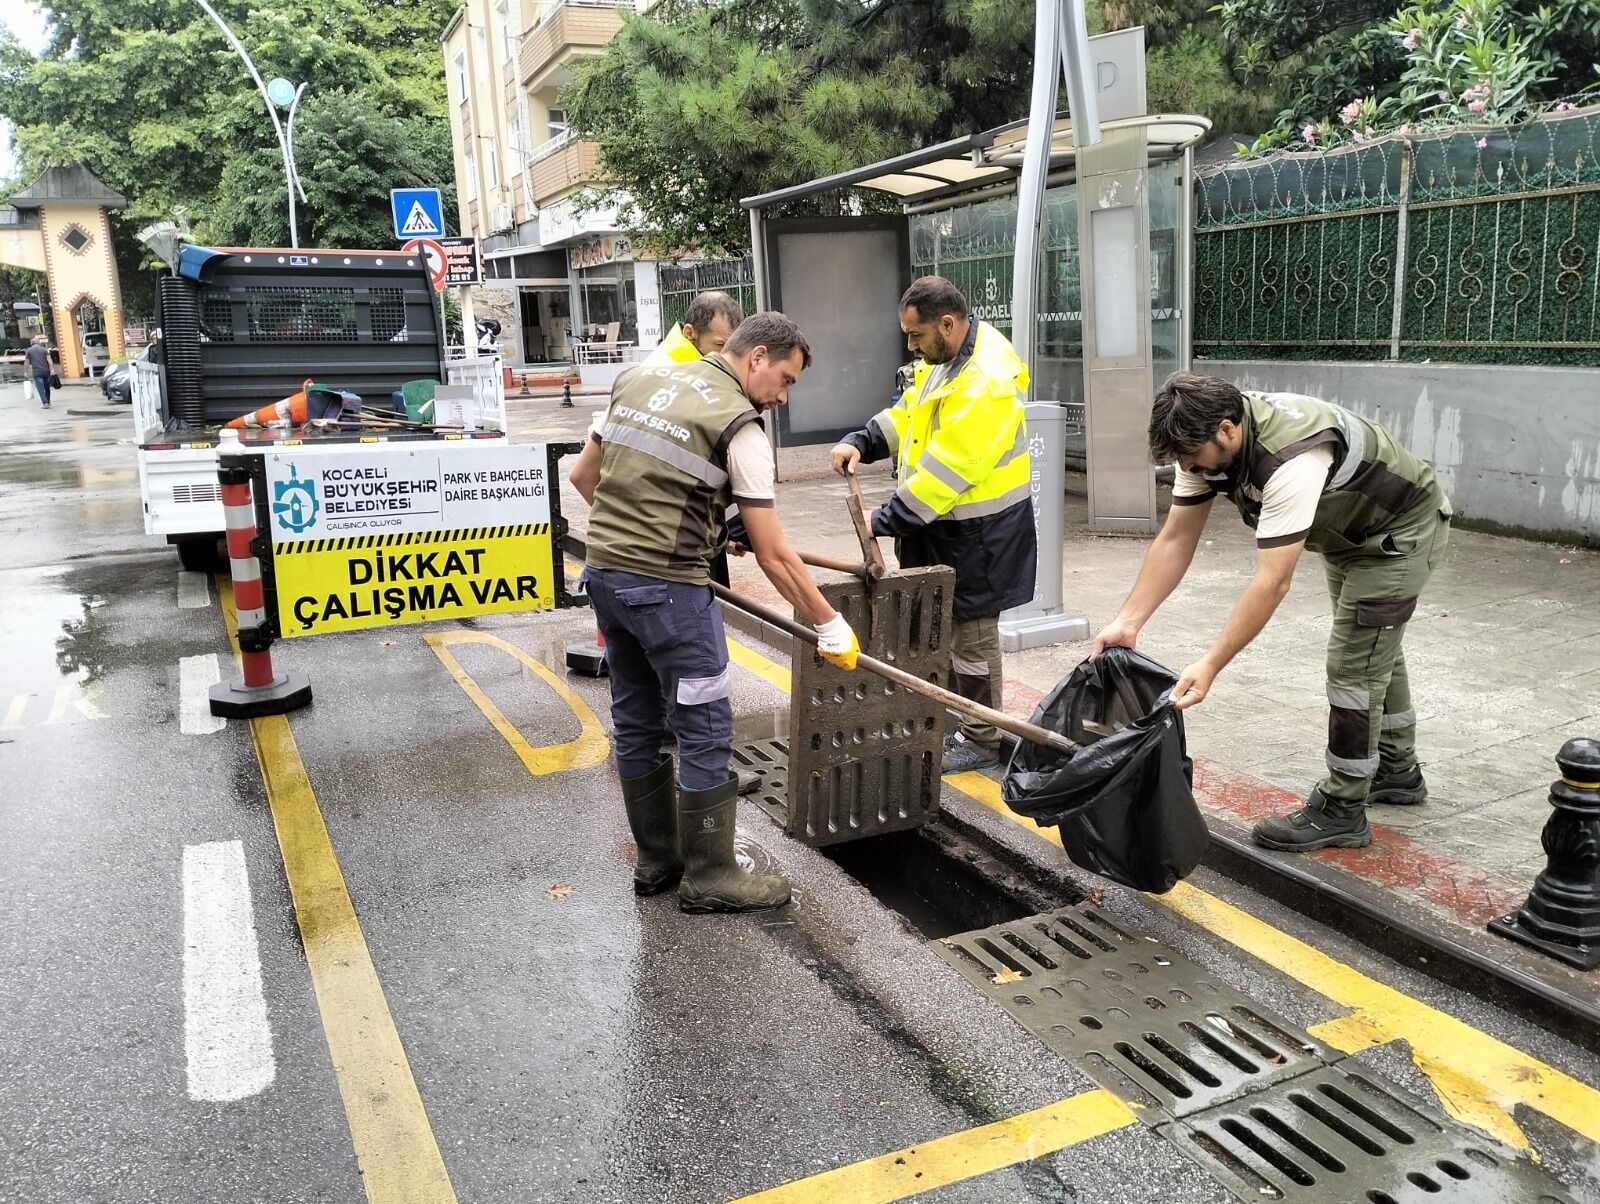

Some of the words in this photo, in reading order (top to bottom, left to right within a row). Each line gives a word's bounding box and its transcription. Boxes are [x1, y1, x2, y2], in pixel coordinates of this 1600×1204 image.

[444, 472, 472, 484] PARK
[474, 471, 487, 483] VE
[490, 469, 543, 484] BAHÇELER
[445, 487, 478, 502] DAİRE
[481, 483, 545, 501] BAŞKANLIĞI
[370, 519, 402, 528] OLUYOR
[348, 548, 486, 586] DİKKAT
[293, 582, 464, 630] ÇALIŞMA
[469, 575, 540, 605] VAR
